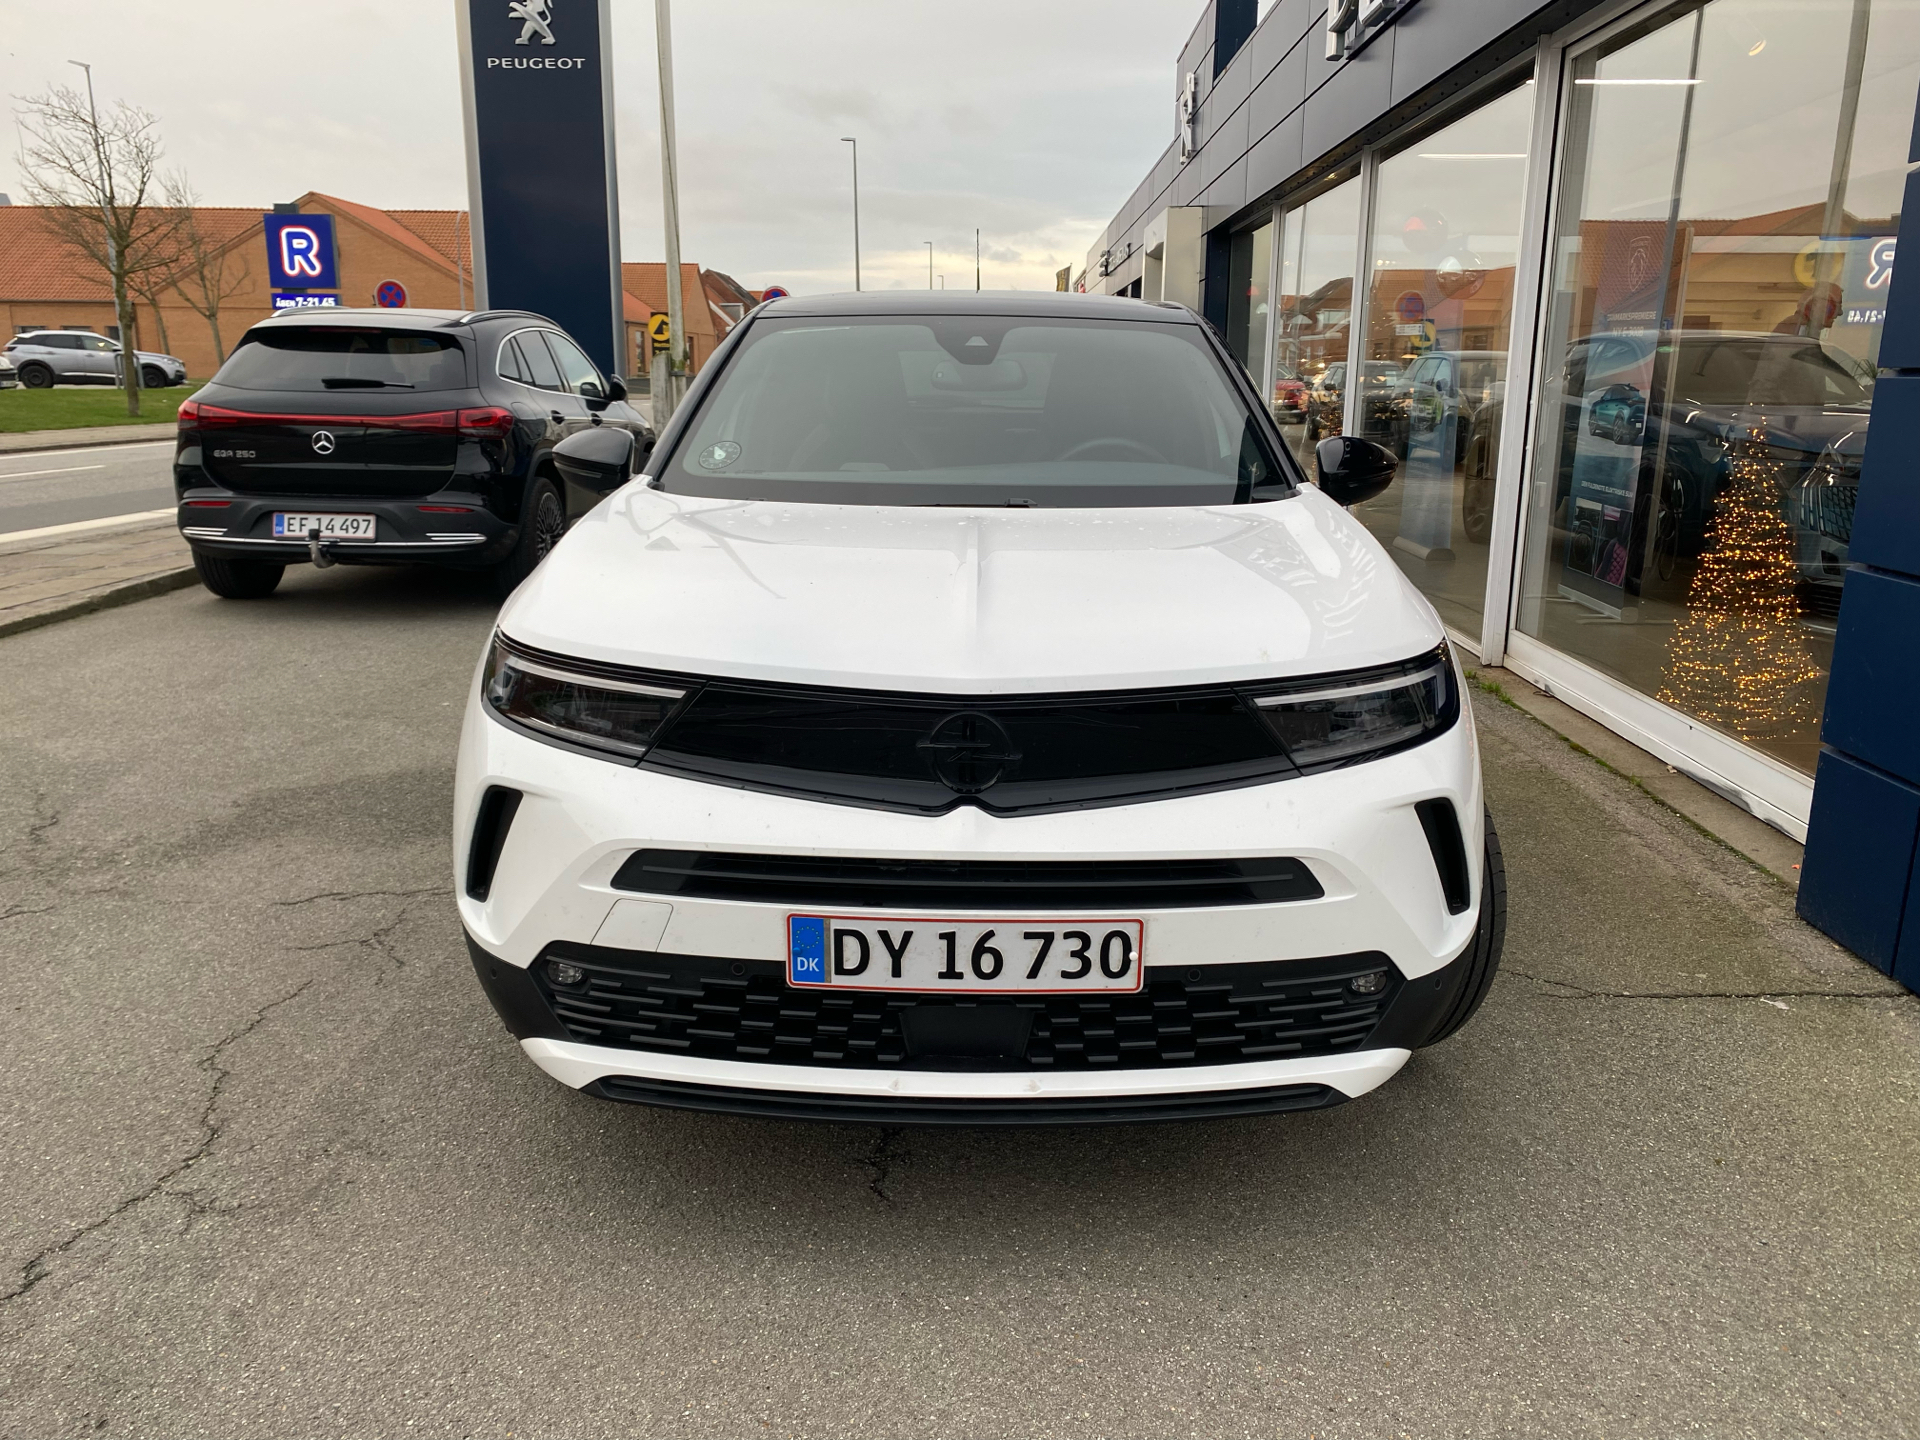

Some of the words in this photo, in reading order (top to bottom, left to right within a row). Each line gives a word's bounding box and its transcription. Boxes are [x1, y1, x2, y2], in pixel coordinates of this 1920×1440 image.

[487, 57, 586, 69] PEUGEOT
[279, 225, 322, 277] R
[213, 450, 234, 458] EQA
[235, 450, 256, 458] 250
[287, 517, 309, 532] EF
[315, 518, 335, 534] 14
[340, 518, 371, 534] 497
[833, 928, 914, 979] DY
[937, 929, 1004, 980] 16
[1023, 929, 1133, 980] 730
[797, 957, 819, 972] DK
